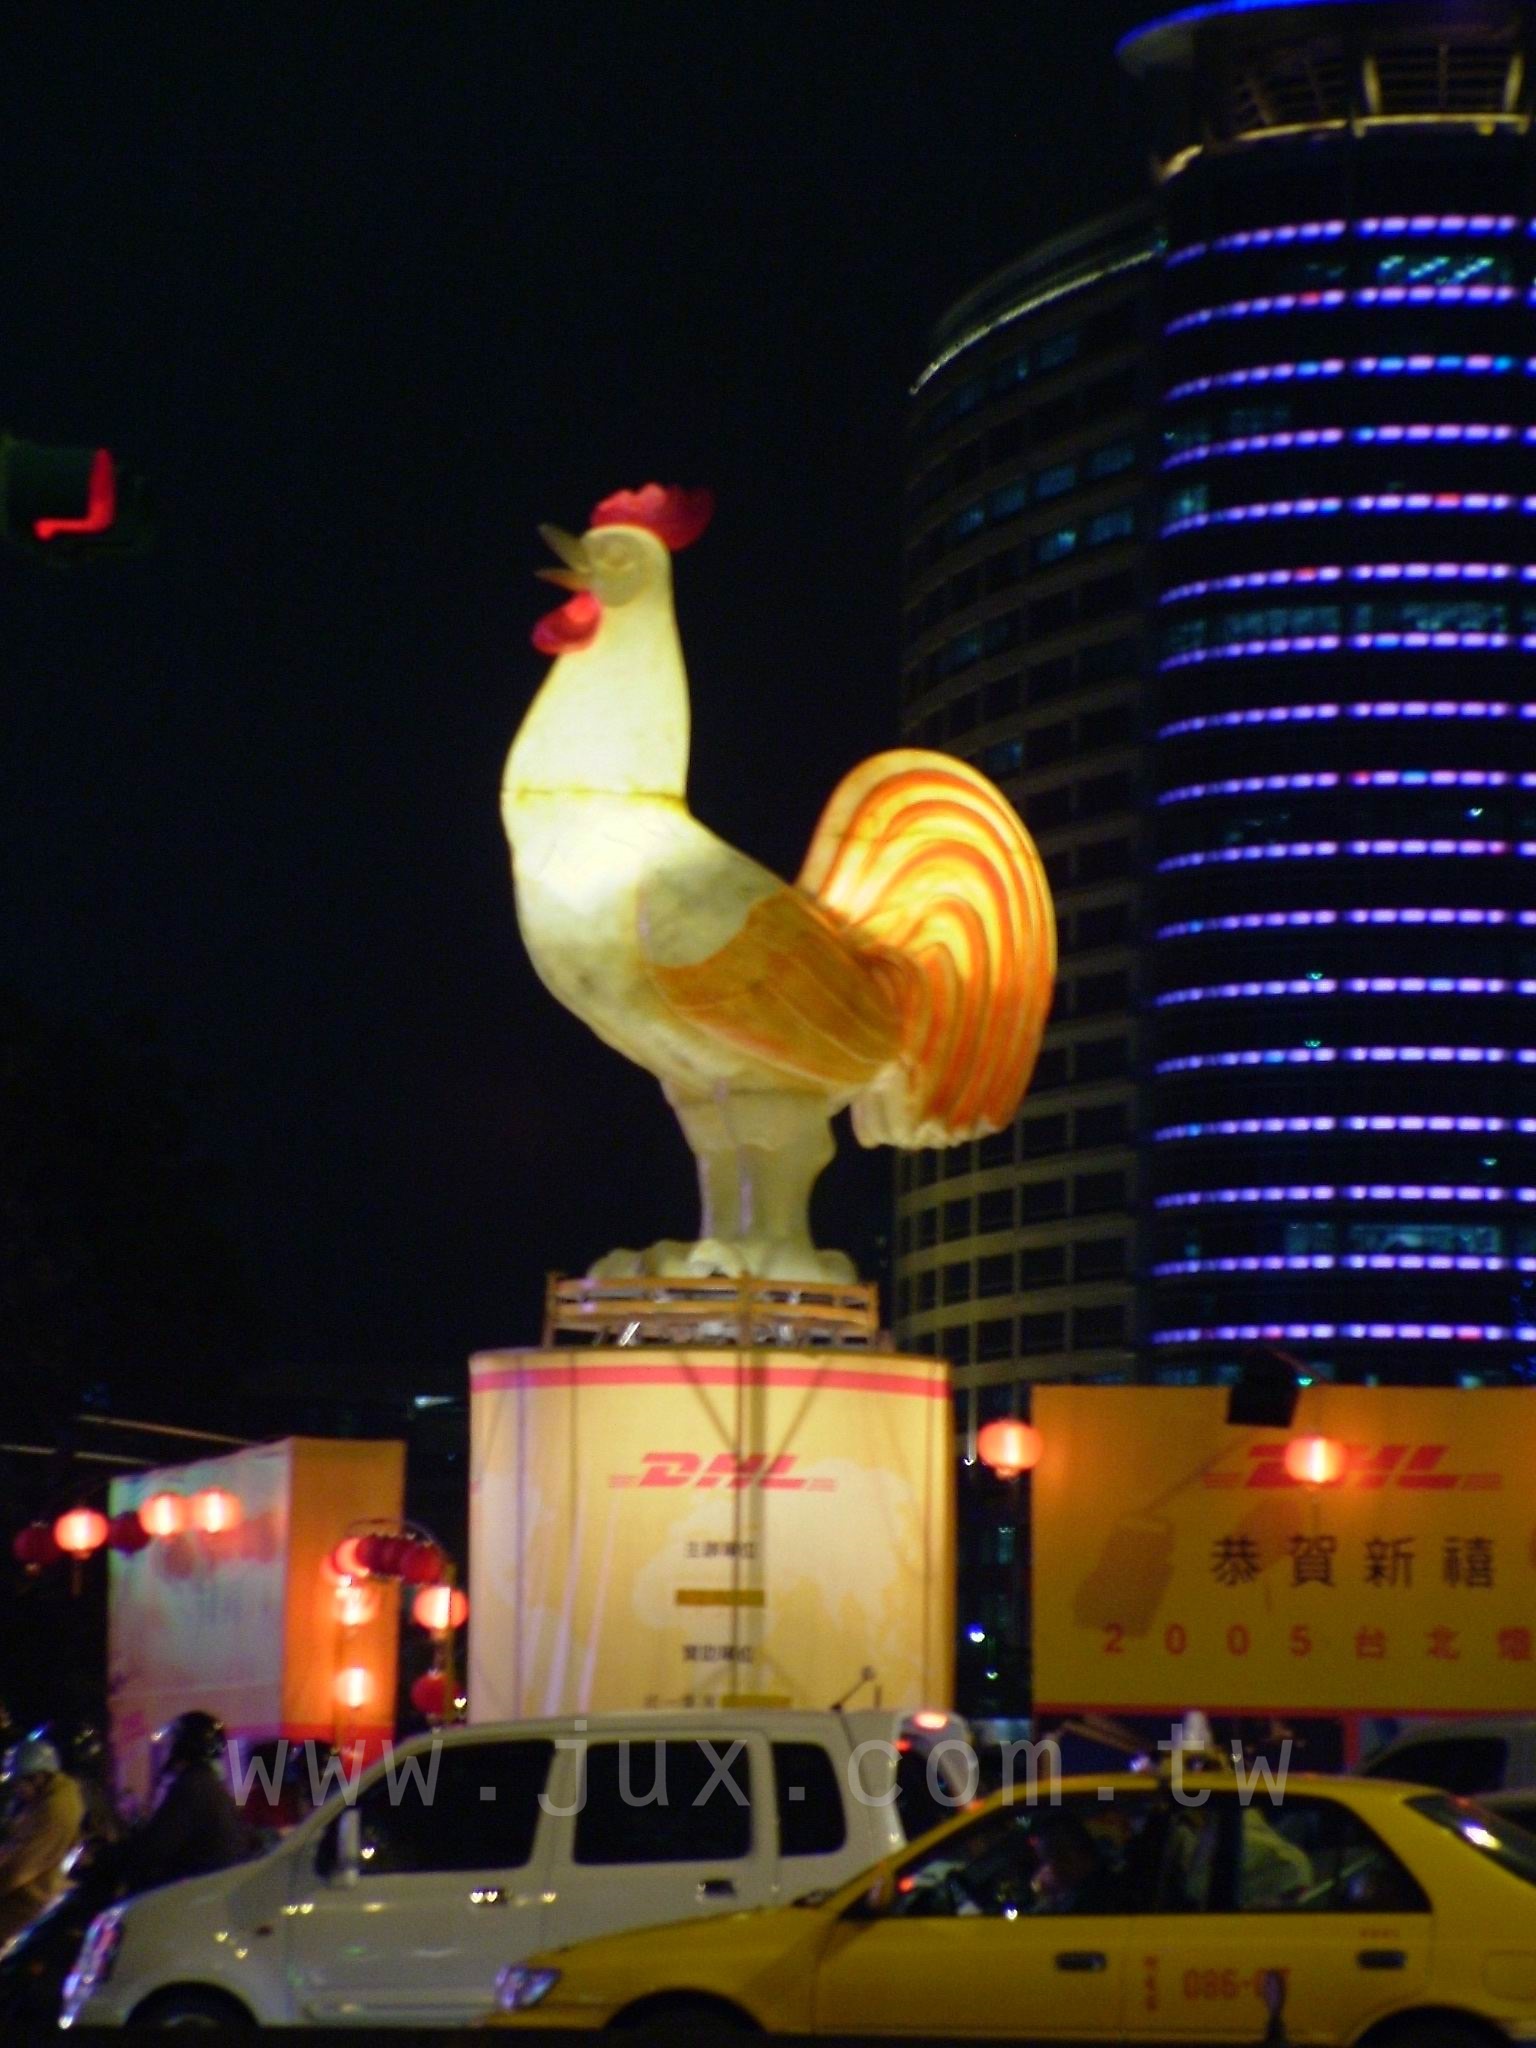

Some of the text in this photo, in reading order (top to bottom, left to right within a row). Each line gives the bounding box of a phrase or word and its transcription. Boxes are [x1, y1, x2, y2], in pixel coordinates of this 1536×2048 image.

[640, 1452, 805, 1487] DHL
[1212, 1535, 1496, 1590] 恭賀新禧
